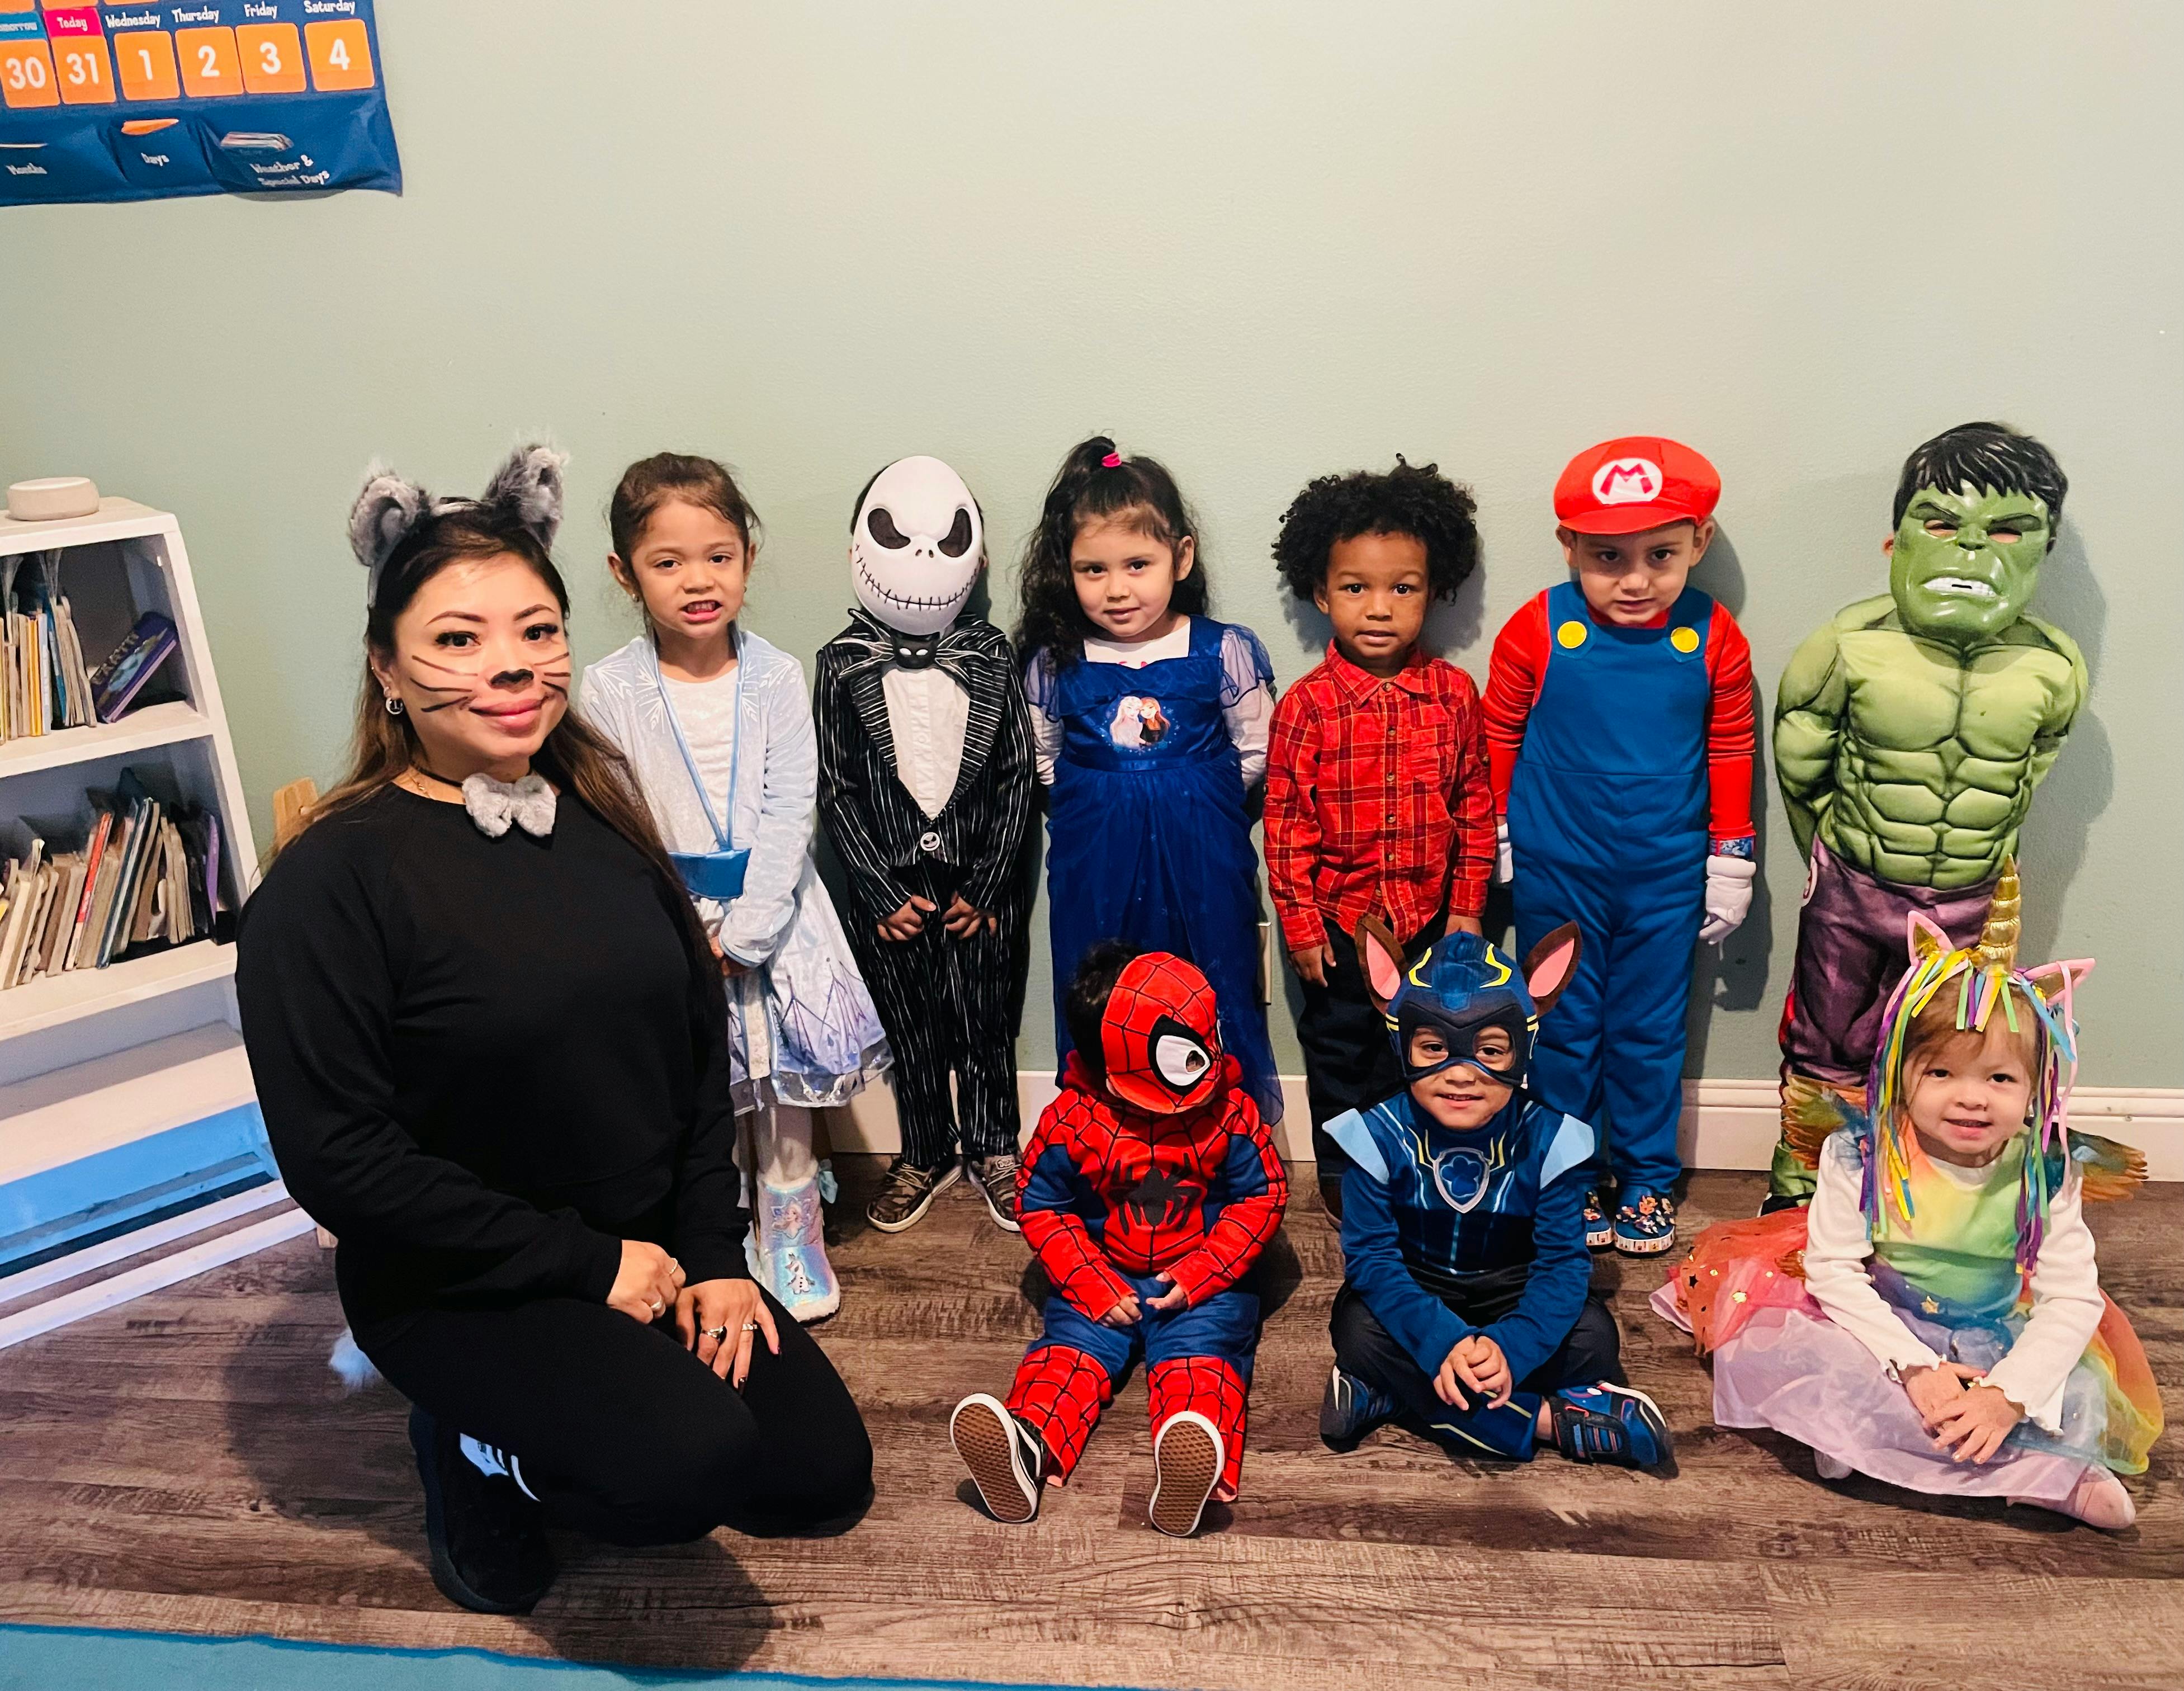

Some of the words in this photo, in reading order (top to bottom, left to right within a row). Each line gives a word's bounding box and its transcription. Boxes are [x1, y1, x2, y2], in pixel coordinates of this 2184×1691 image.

[56, 16, 88, 32] Today
[105, 11, 161, 28] Wednesday
[171, 5, 219, 23] Thursday
[244, 1, 277, 19] Friday
[304, 0, 356, 15] Saturday
[6, 56, 46, 89] 30
[67, 53, 99, 84] 31
[138, 49, 153, 80] 1
[198, 45, 220, 77] 2
[259, 42, 281, 74] 3
[329, 39, 351, 70] 4
[140, 152, 170, 167] Days
[300, 154, 314, 167] &
[300, 170, 330, 185] Days
[1600, 462, 1653, 496] M
